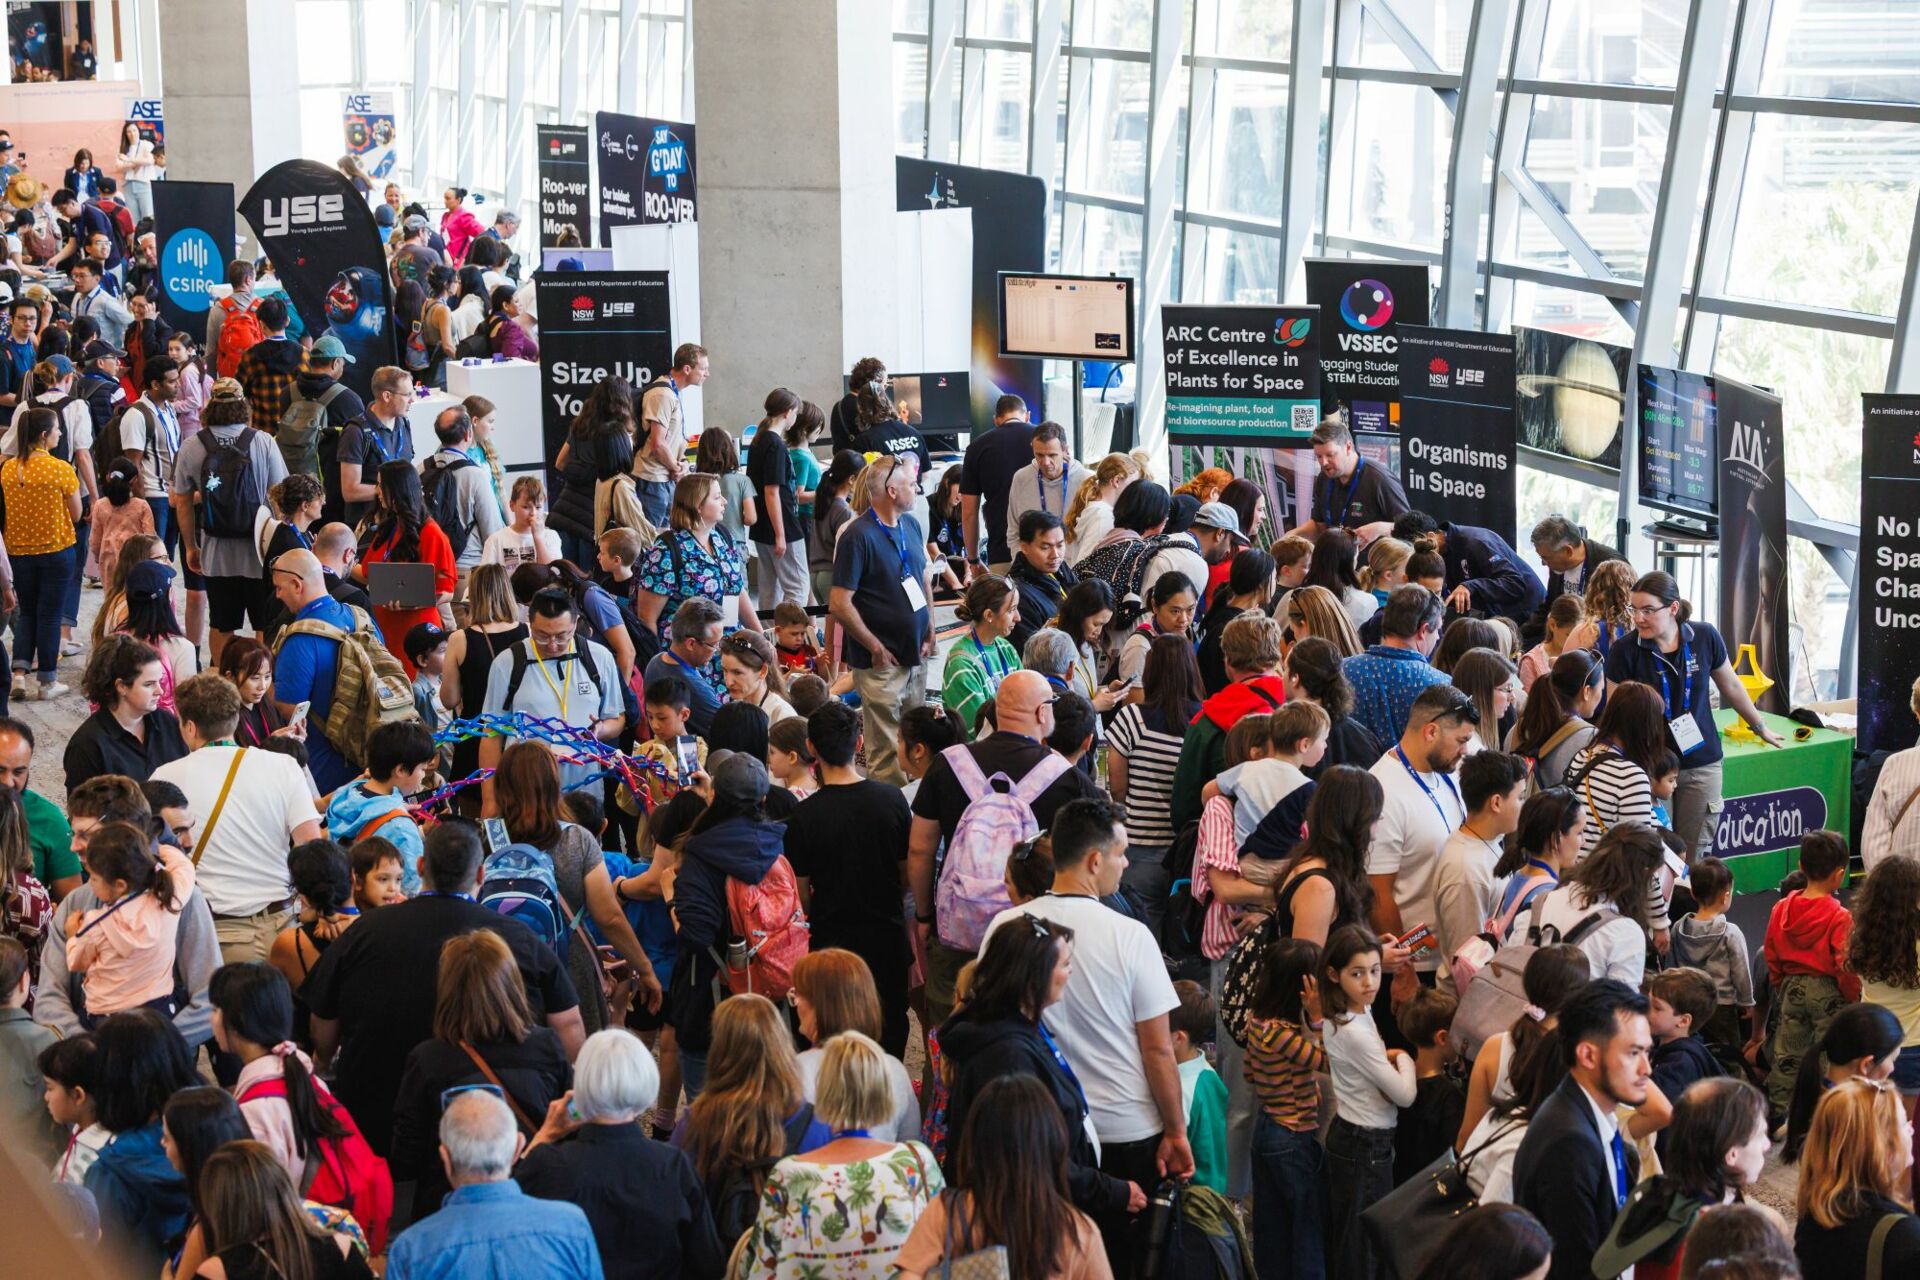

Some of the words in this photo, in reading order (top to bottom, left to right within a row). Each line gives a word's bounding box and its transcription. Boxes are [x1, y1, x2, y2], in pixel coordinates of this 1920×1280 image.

[131, 101, 162, 118] ASE
[346, 95, 371, 112] ASE
[656, 129, 668, 145] SAY
[652, 146, 683, 172] G'DAY
[542, 177, 587, 195] Roo-ver
[666, 173, 677, 188] TO
[263, 194, 344, 237] yse
[542, 200, 555, 214] to
[557, 199, 577, 215] the
[645, 191, 694, 223] ROO-VER
[572, 310, 595, 318] NSW
[602, 302, 635, 317] yse
[1166, 326, 1202, 341] ARC
[1208, 327, 1266, 342] Centre
[1338, 333, 1398, 353] VSSEC
[1455, 341, 1482, 350] Department
[1488, 345, 1512, 353] Education
[1167, 349, 1184, 364] of
[1189, 350, 1278, 366] Excellence
[1283, 351, 1298, 366] in
[552, 361, 608, 384] Size
[615, 361, 652, 388] Up
[1168, 372, 1217, 388] Plants
[1223, 373, 1248, 388] for
[1253, 374, 1304, 393] Space
[1327, 373, 1356, 383] STEM
[1429, 373, 1449, 384] NSW
[1456, 368, 1485, 385] yse
[1225, 404, 1250, 414] plant,
[1253, 404, 1273, 414] food
[1882, 408, 1914, 416] initiative
[1183, 416, 1236, 426] bioresource
[1238, 418, 1288, 428] production
[885, 436, 919, 451] VSSEC
[1409, 437, 1507, 470] Organisms
[1409, 468, 1424, 490] in
[1429, 472, 1485, 499] Space
[1877, 516, 1910, 537] No
